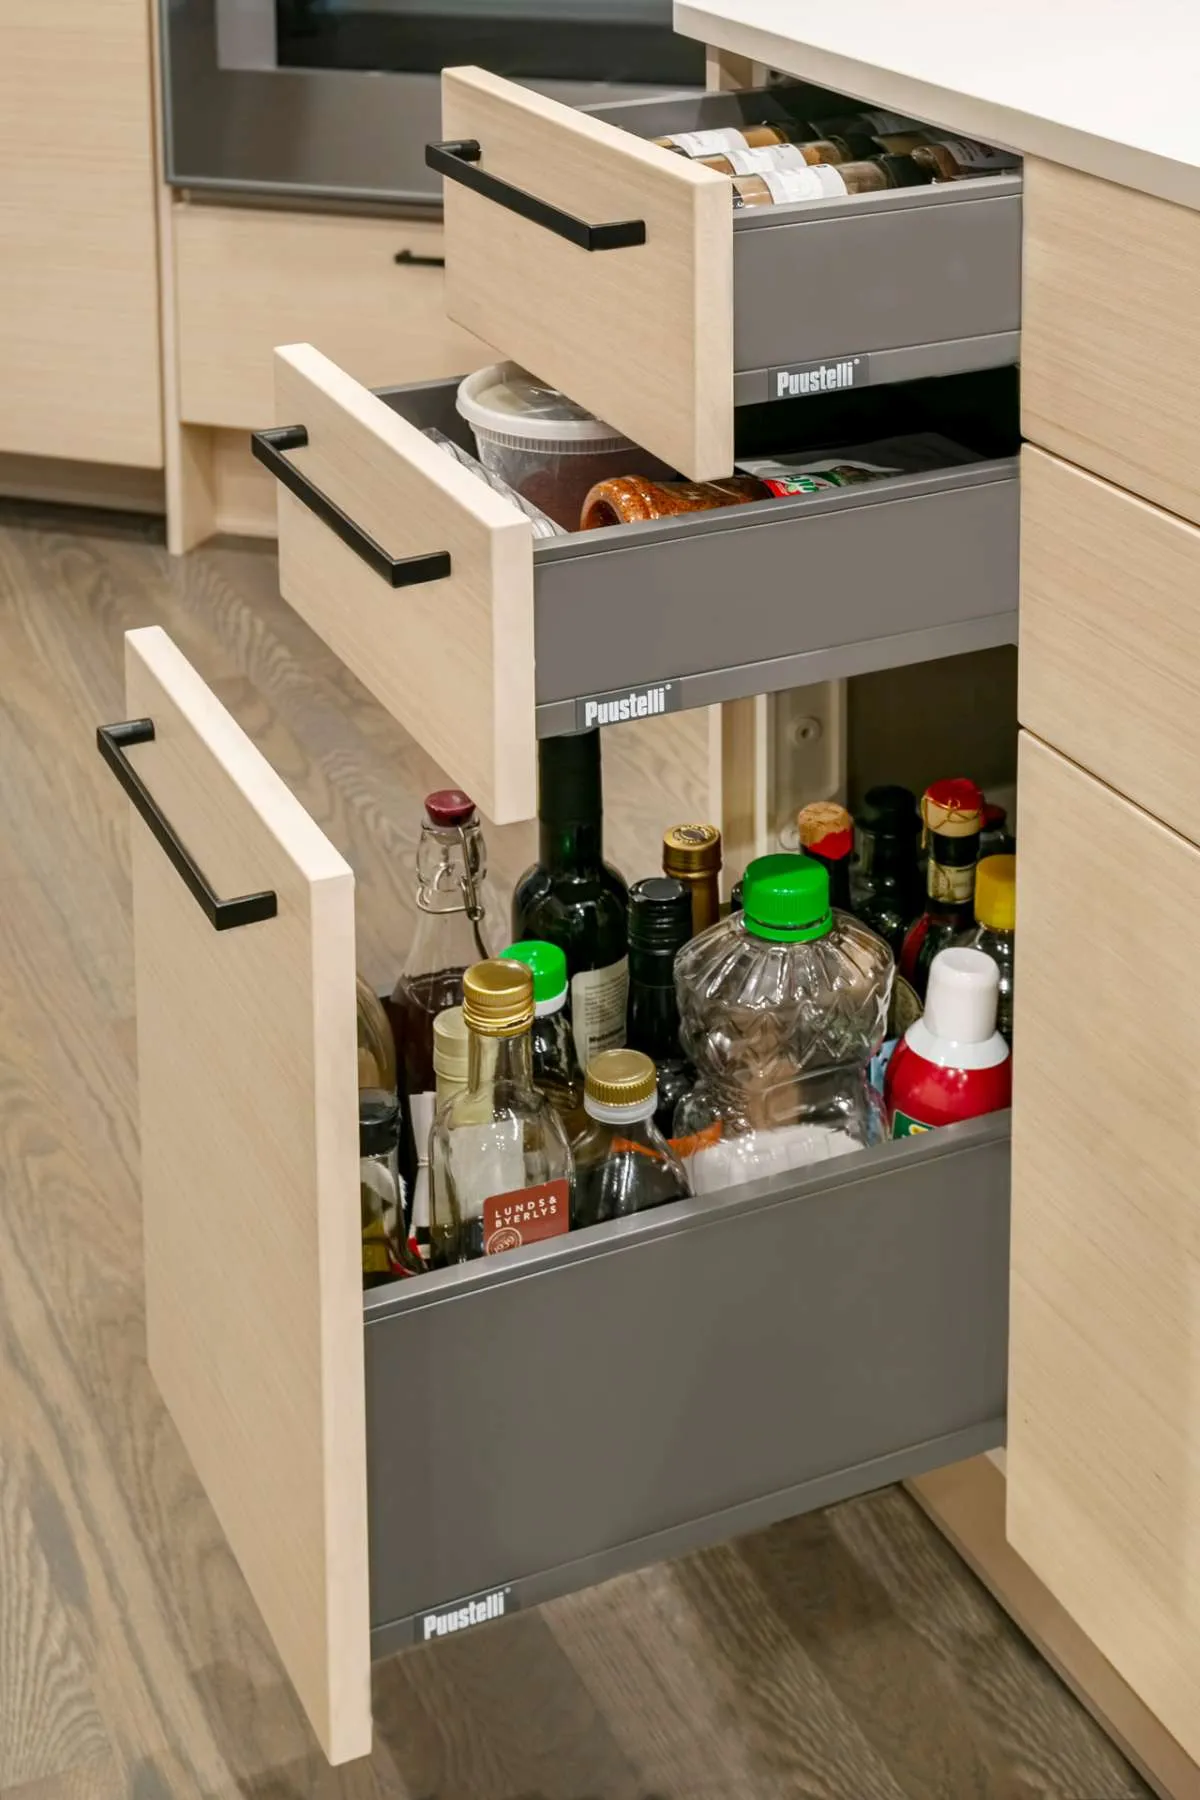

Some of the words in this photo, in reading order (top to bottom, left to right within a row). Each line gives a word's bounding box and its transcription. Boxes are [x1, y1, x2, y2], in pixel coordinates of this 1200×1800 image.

[777, 361, 854, 397] Puustelli
[585, 687, 665, 728] Puustelli
[495, 1206, 557, 1229] BYERLYS
[424, 1591, 504, 1641] Puustelli
